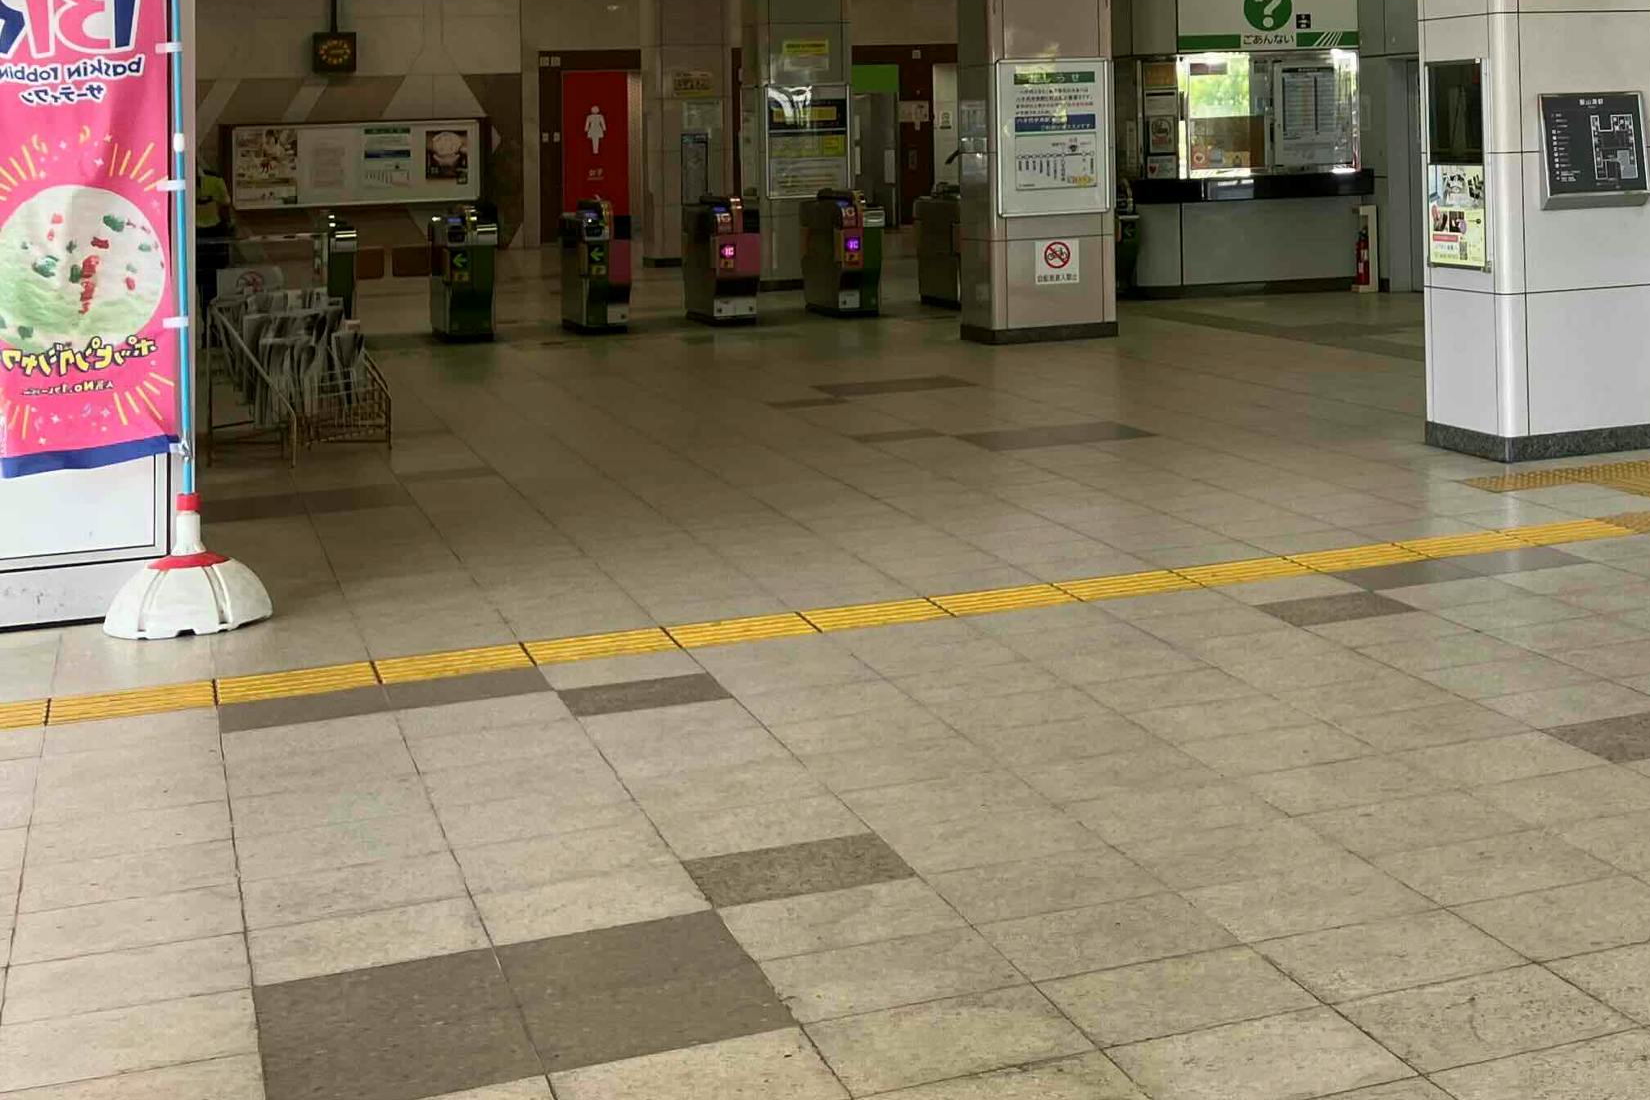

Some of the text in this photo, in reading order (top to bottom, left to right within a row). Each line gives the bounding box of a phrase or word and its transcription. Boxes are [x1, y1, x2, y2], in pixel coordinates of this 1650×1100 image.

[1244, 35, 1294, 46] ごあんない
